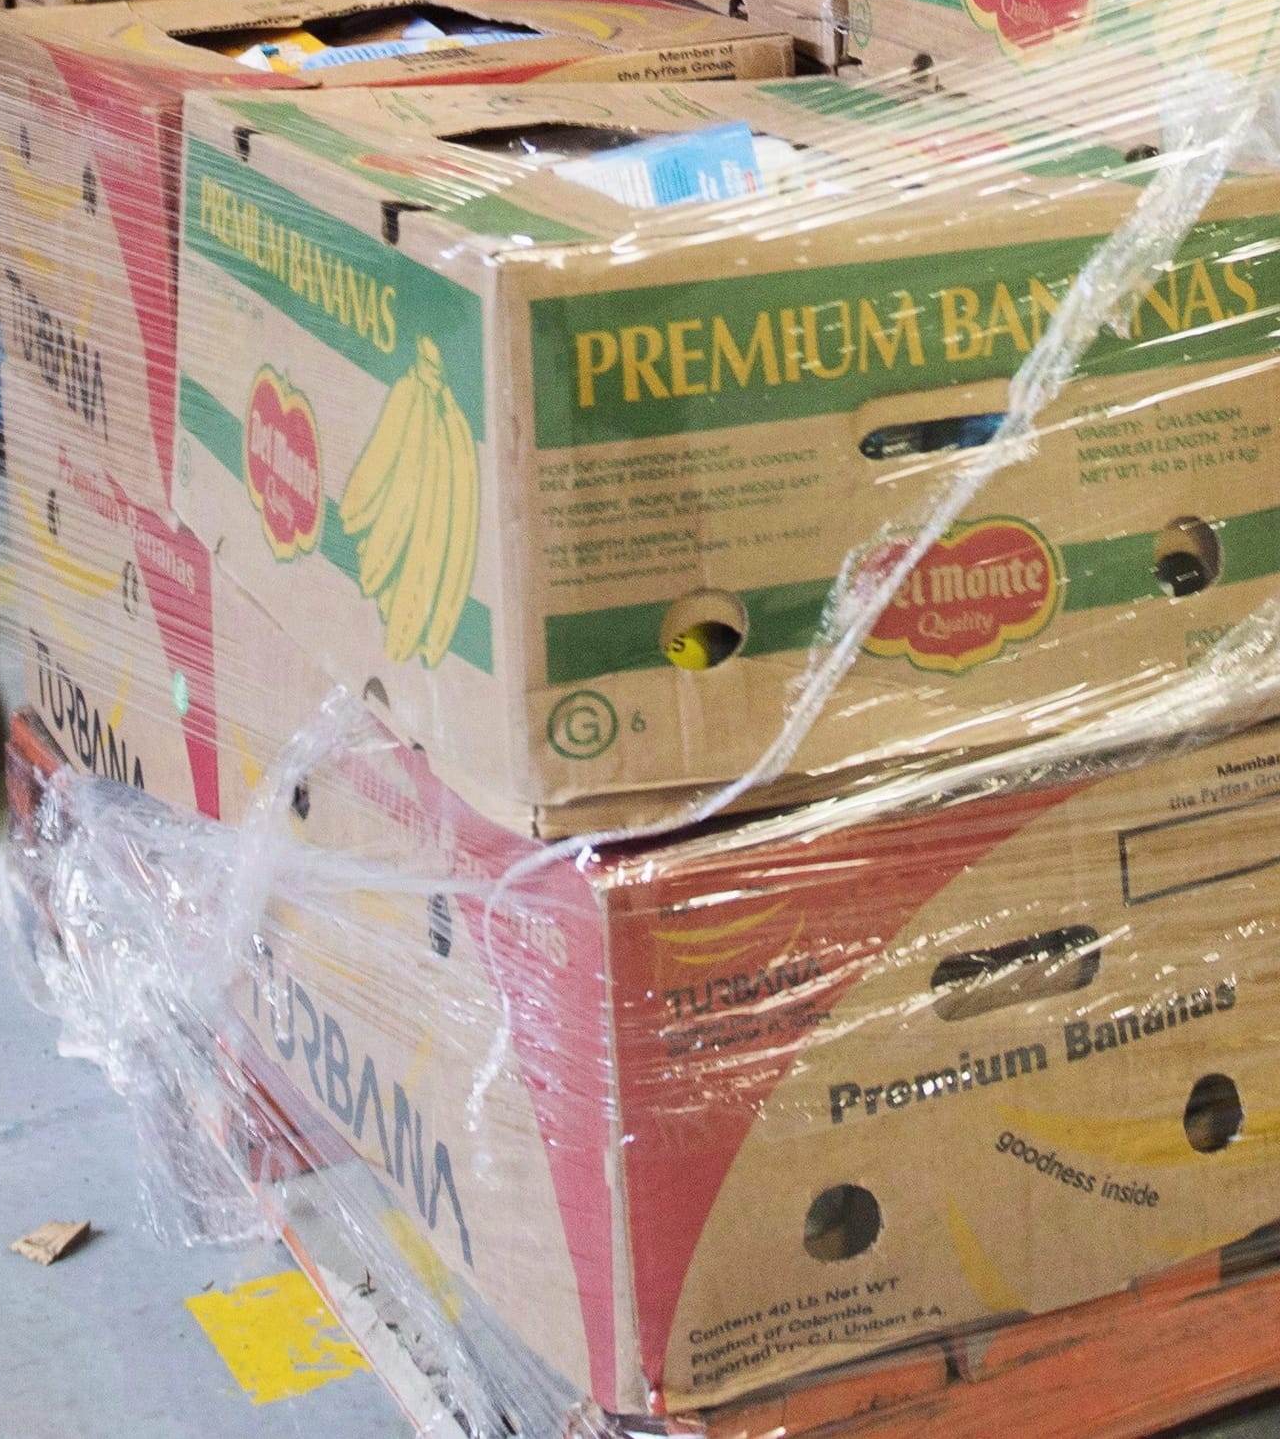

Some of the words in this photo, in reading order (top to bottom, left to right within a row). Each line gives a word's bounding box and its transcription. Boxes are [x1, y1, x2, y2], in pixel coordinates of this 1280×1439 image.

[617, 70, 640, 82] the
[659, 48, 715, 62] Member
[720, 44, 733, 55] of
[288, 229, 396, 354] BANANAS
[575, 299, 926, 407] PREMIUM
[939, 259, 1260, 361] BANNAS
[929, 560, 1043, 604] Monte
[919, 612, 994, 640] Quality
[31, 637, 145, 794] TURBANA
[565, 705, 600, 746] G
[664, 956, 822, 1018] TURBANA
[829, 1052, 1048, 1124] Premium
[1063, 972, 1237, 1062] Bananas
[253, 935, 475, 1270] TURBANA
[995, 1131, 1095, 1194] goodness
[1101, 1173, 1160, 1208] inside
[689, 1312, 762, 1345] Content
[767, 1301, 790, 1316] 40
[825, 1287, 858, 1304] Net
[866, 1275, 900, 1294] WT
[691, 1333, 758, 1367] Product
[763, 1326, 783, 1340] of
[788, 1304, 873, 1332] Colombia
[693, 1350, 769, 1386] Exported
